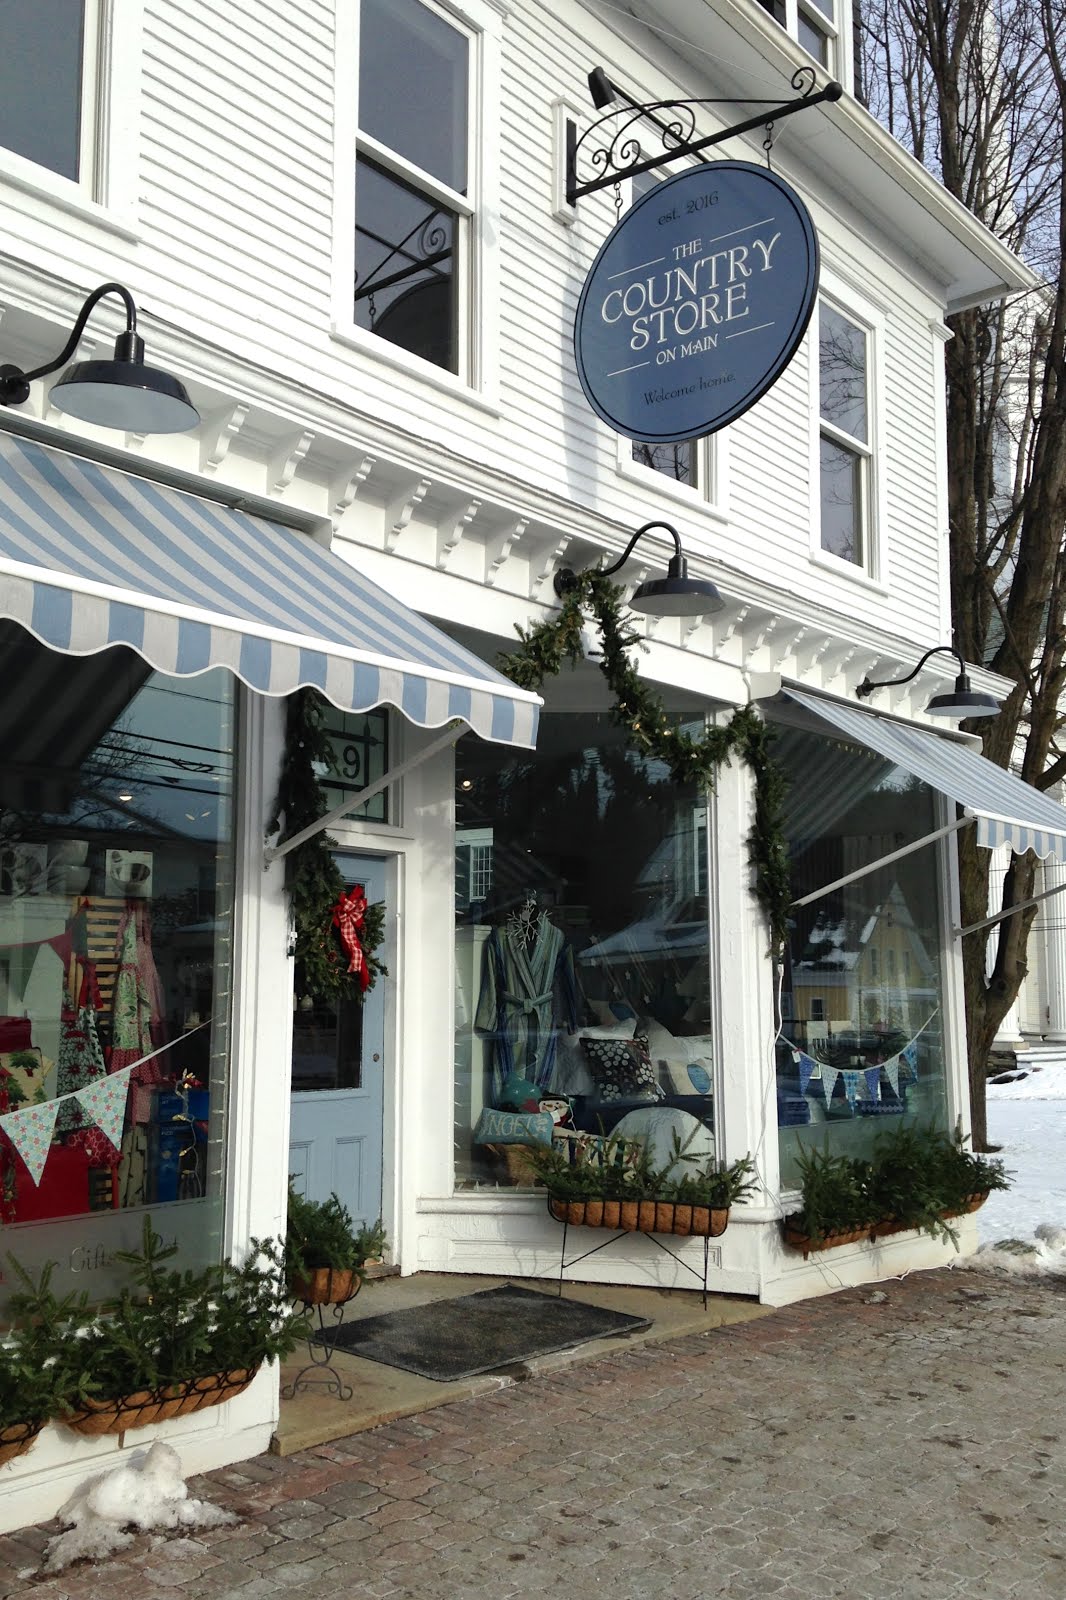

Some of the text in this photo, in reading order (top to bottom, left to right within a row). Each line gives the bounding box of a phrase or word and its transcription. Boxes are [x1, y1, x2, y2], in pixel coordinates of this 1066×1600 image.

[658, 190, 719, 226] est. 2016
[672, 238, 703, 260] THE
[601, 232, 781, 324] COUNTRY
[630, 282, 749, 351] STORE
[656, 334, 719, 365] ON MAIN
[643, 384, 696, 406] Welcome
[487, 1114, 537, 1137] NOEL
